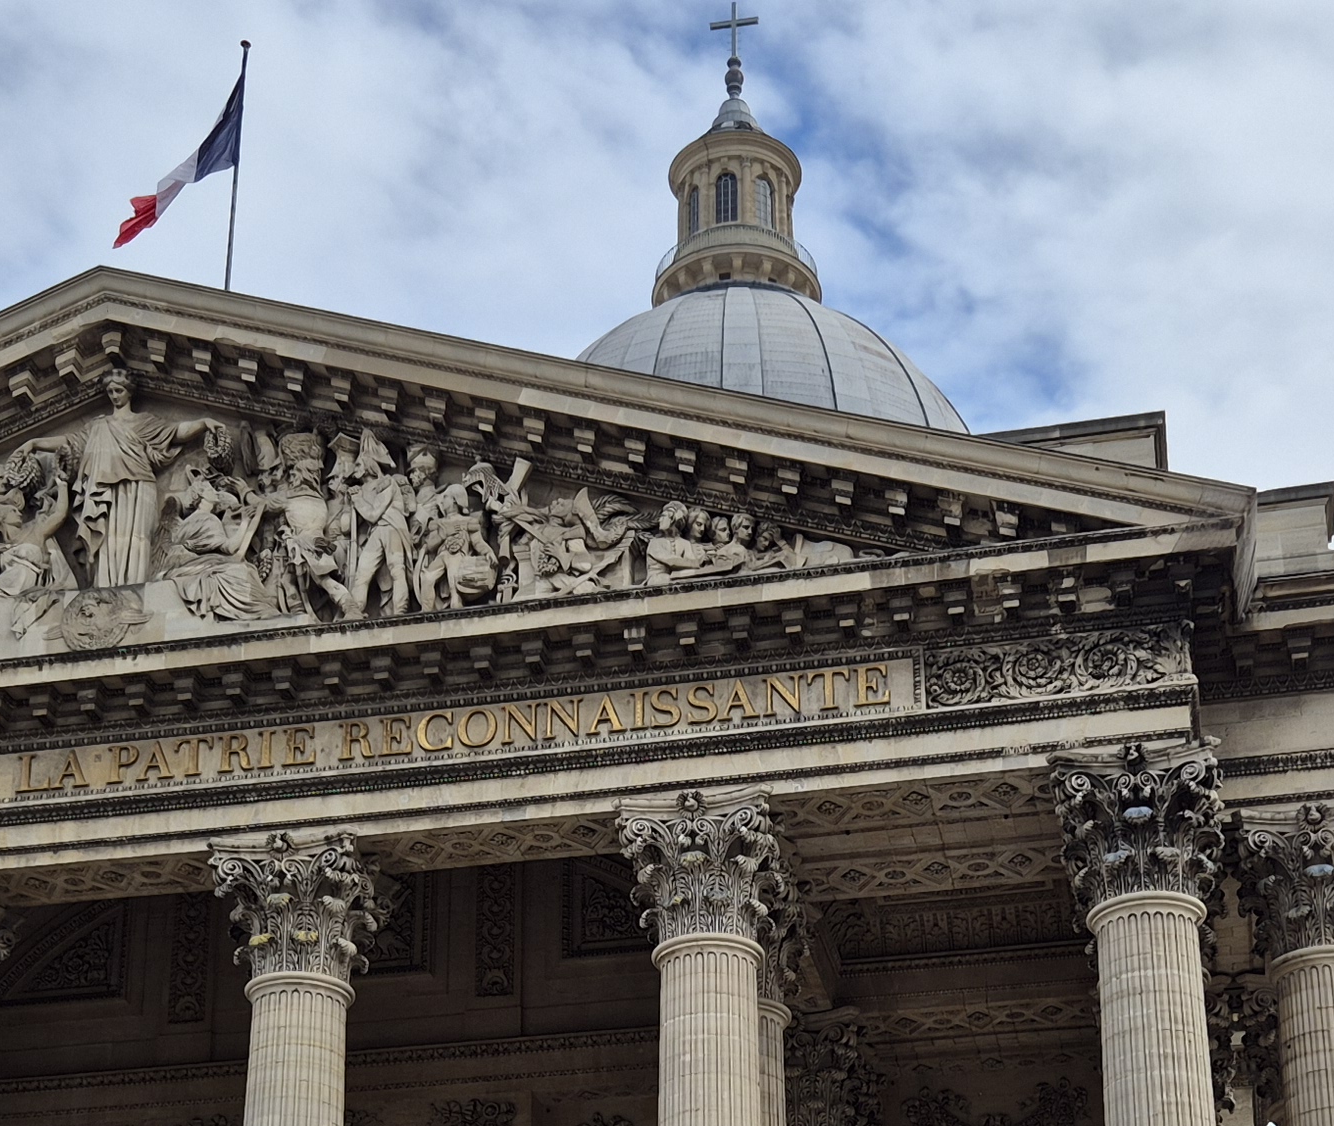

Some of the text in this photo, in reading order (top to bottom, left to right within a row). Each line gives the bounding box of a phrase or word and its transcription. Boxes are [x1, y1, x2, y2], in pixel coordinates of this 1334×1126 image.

[15, 749, 90, 793] LA
[105, 724, 317, 785] PATRIE
[336, 664, 892, 762] RECONNAISSANTE
